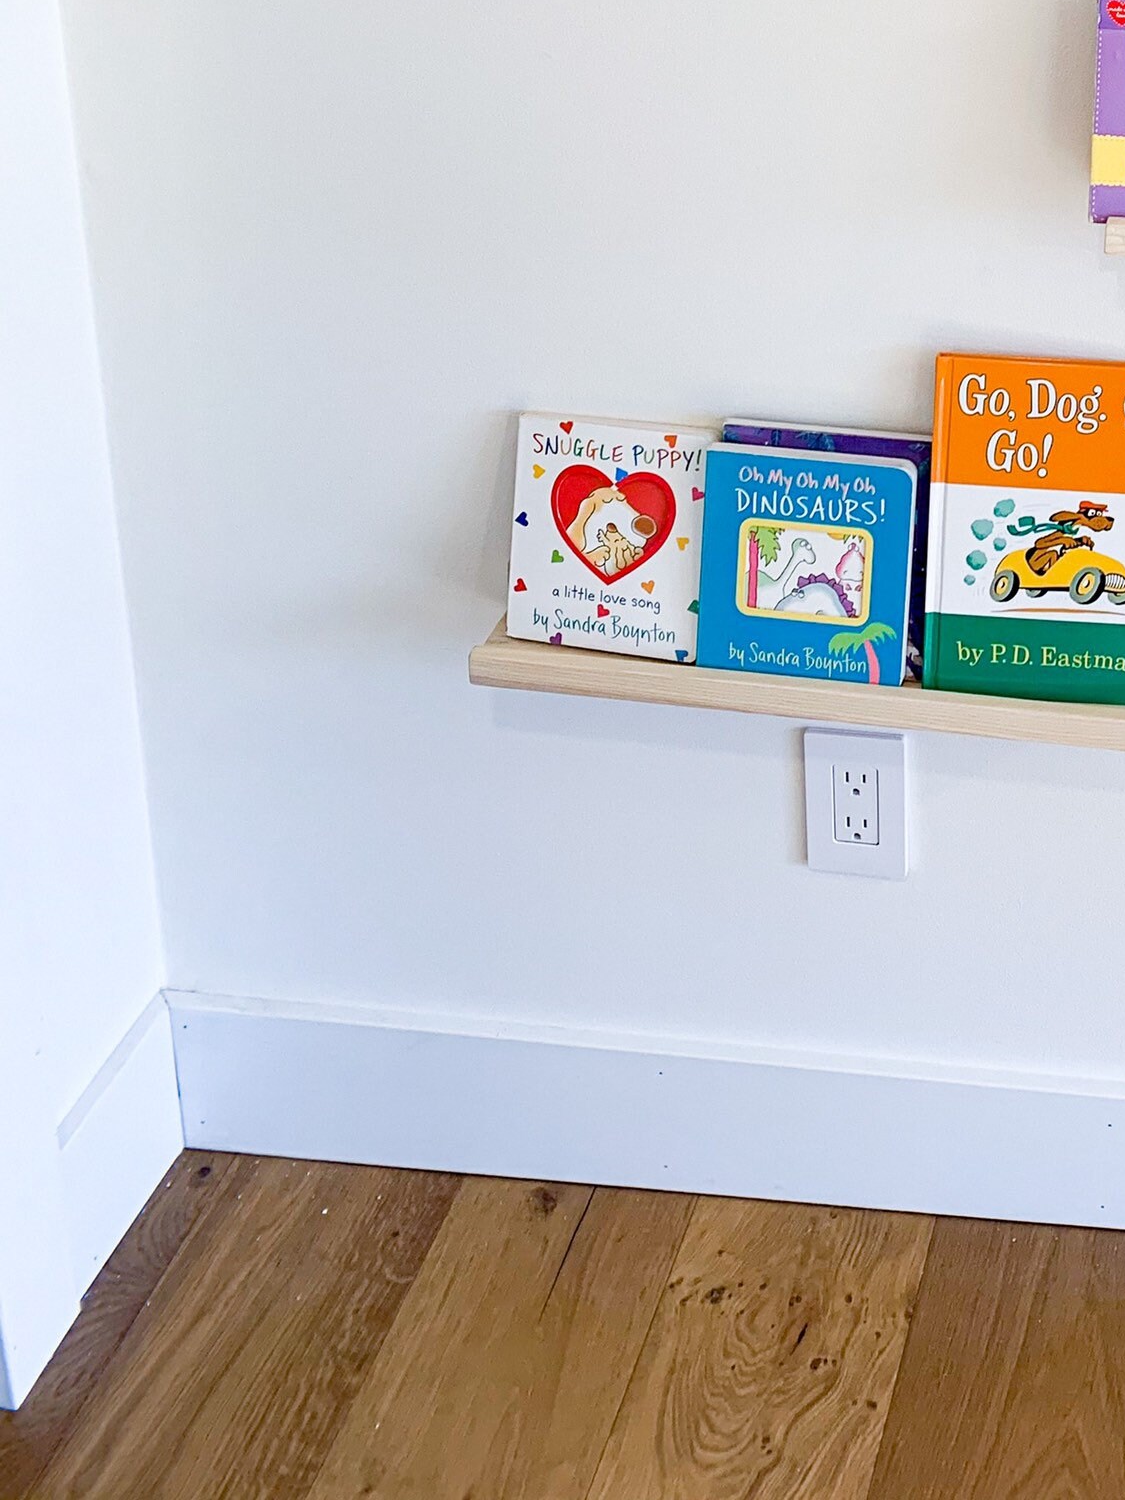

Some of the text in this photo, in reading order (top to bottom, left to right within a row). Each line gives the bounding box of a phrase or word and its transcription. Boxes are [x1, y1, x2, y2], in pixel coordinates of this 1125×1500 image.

[957, 372, 1017, 423] Go,
[532, 433, 702, 473] SNUGGLE PUPPY!
[985, 429, 1055, 480] Go!
[738, 466, 877, 501] Oh My Oh My Oh
[735, 487, 886, 526] DINOSAURS!
[552, 585, 661, 615] a little love song
[532, 608, 676, 647] by Sandra Boynton
[728, 642, 867, 678] by Sandra Boynton
[956, 640, 985, 665] by
